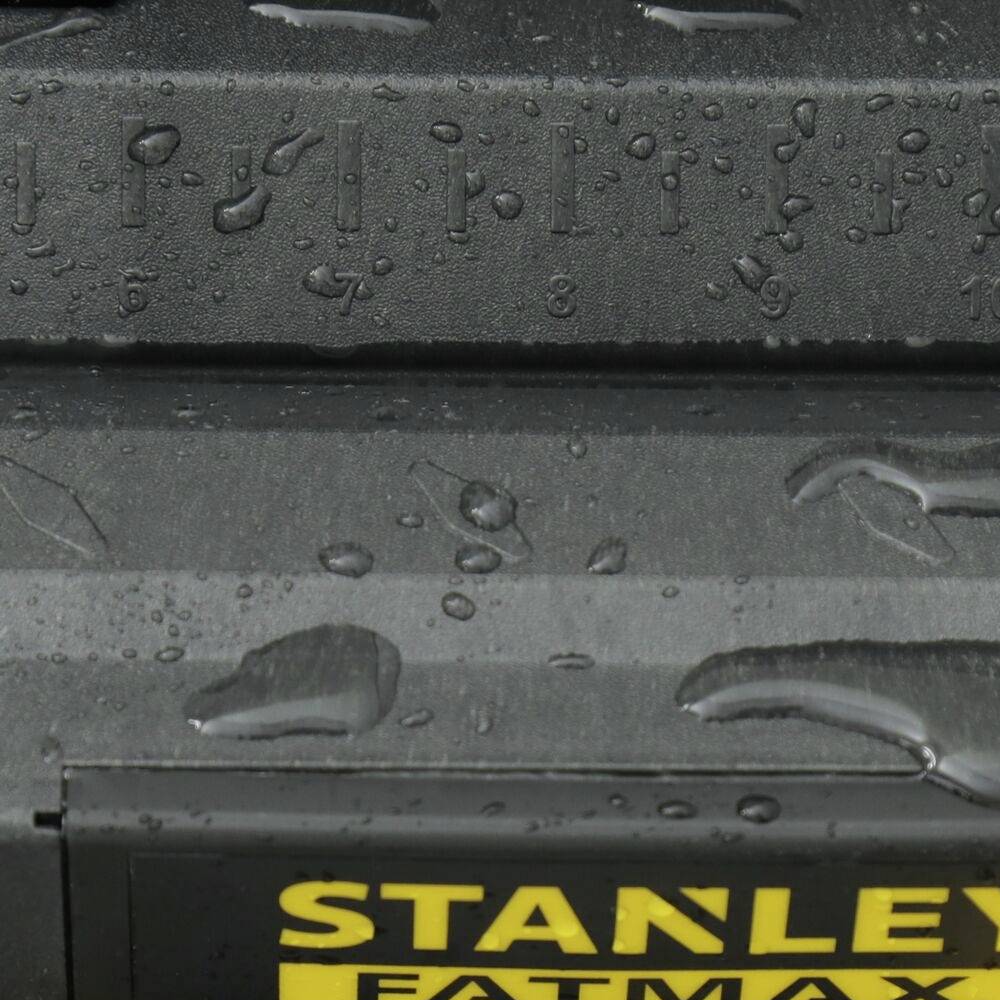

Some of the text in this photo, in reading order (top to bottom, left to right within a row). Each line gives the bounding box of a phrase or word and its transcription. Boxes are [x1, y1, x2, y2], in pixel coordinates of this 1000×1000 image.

[334, 272, 363, 316] 7
[548, 274, 576, 318] 8
[759, 275, 791, 319] 9
